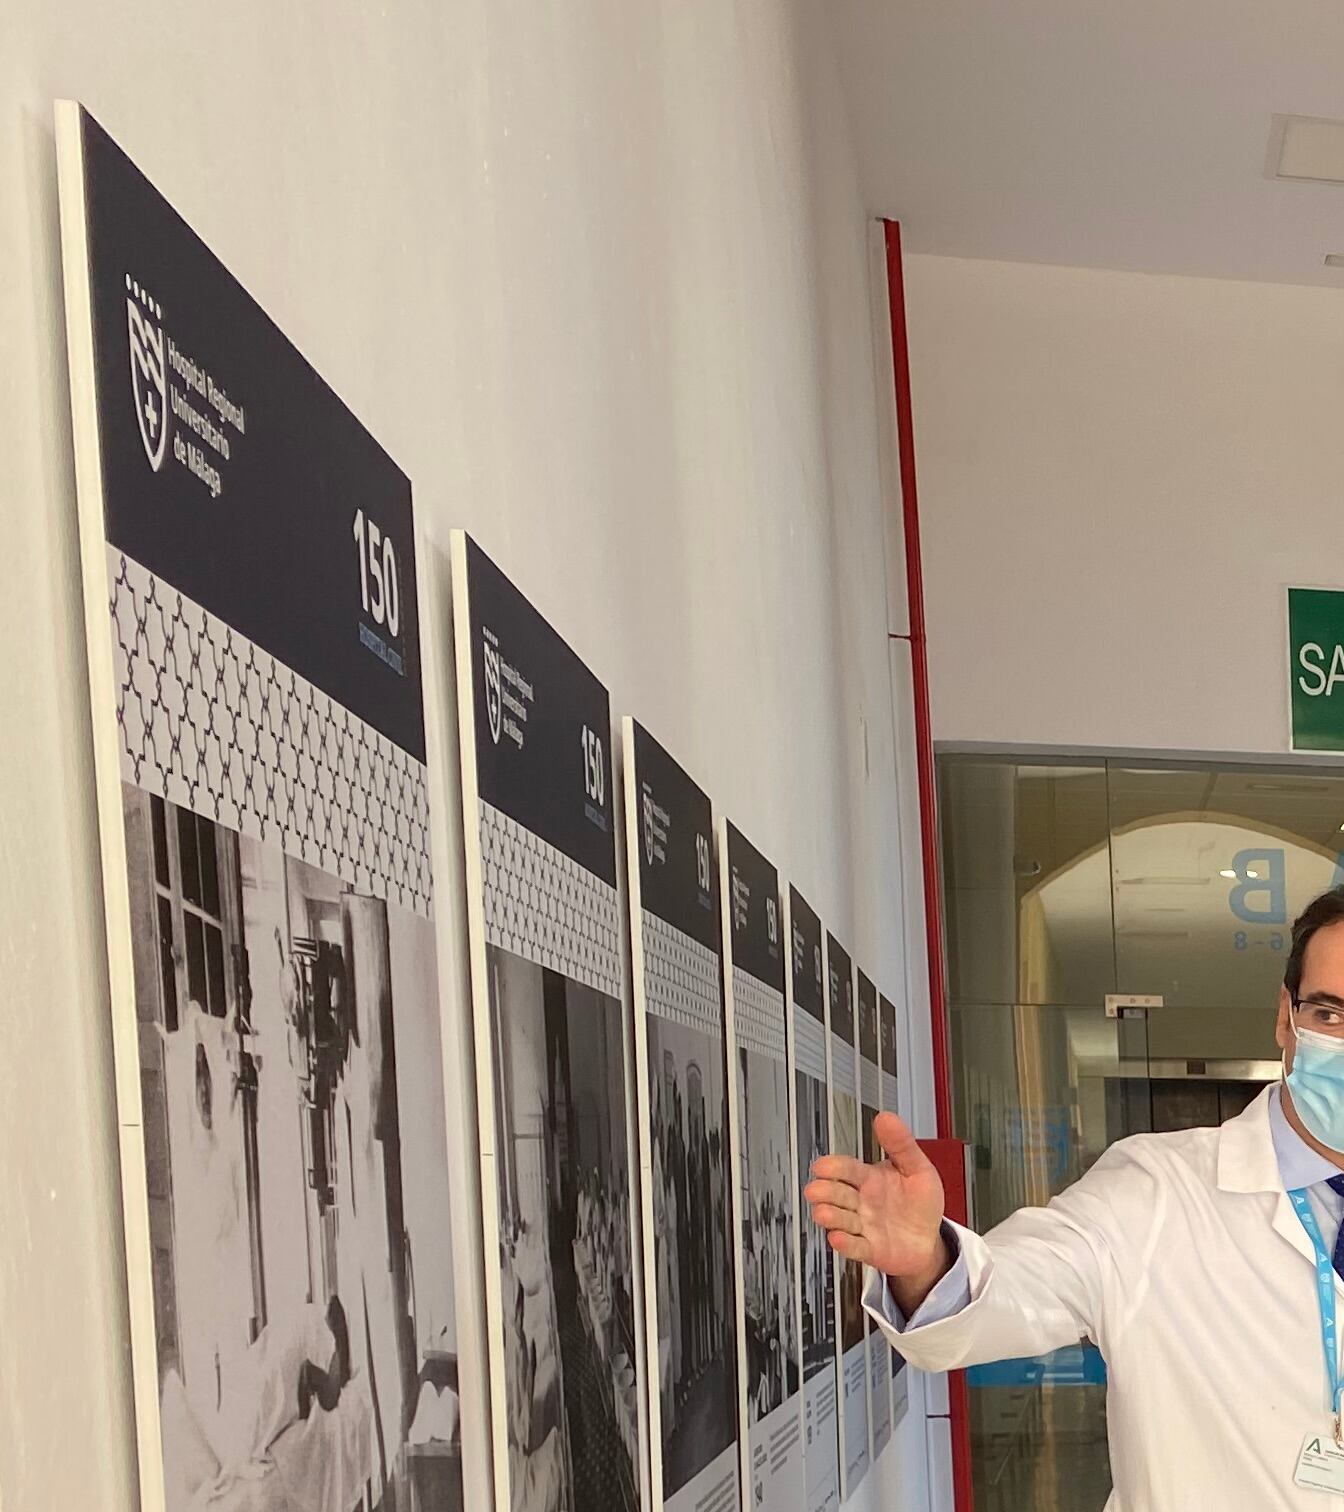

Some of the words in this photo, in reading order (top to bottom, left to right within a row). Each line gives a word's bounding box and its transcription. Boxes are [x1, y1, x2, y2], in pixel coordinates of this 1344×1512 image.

[168, 337, 207, 399] Hospital
[353, 508, 399, 637] 150
[581, 724, 604, 807] 150
